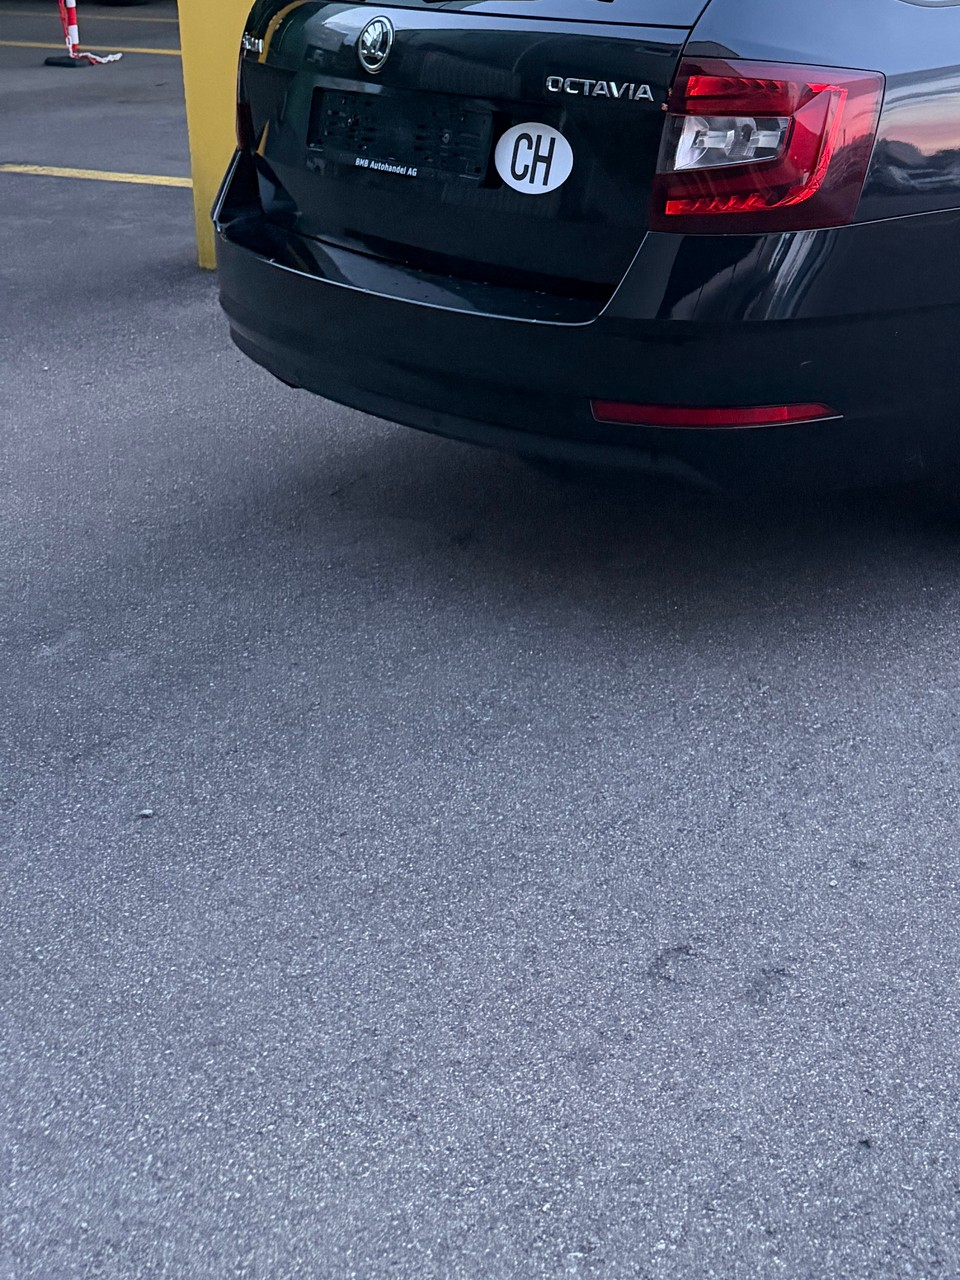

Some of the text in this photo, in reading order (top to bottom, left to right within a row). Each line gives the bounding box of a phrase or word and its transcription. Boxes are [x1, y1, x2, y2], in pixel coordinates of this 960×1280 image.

[545, 76, 655, 102] OCTAVIA
[355, 157, 418, 177] BMB Autohandel AG
[510, 132, 556, 187] CH
